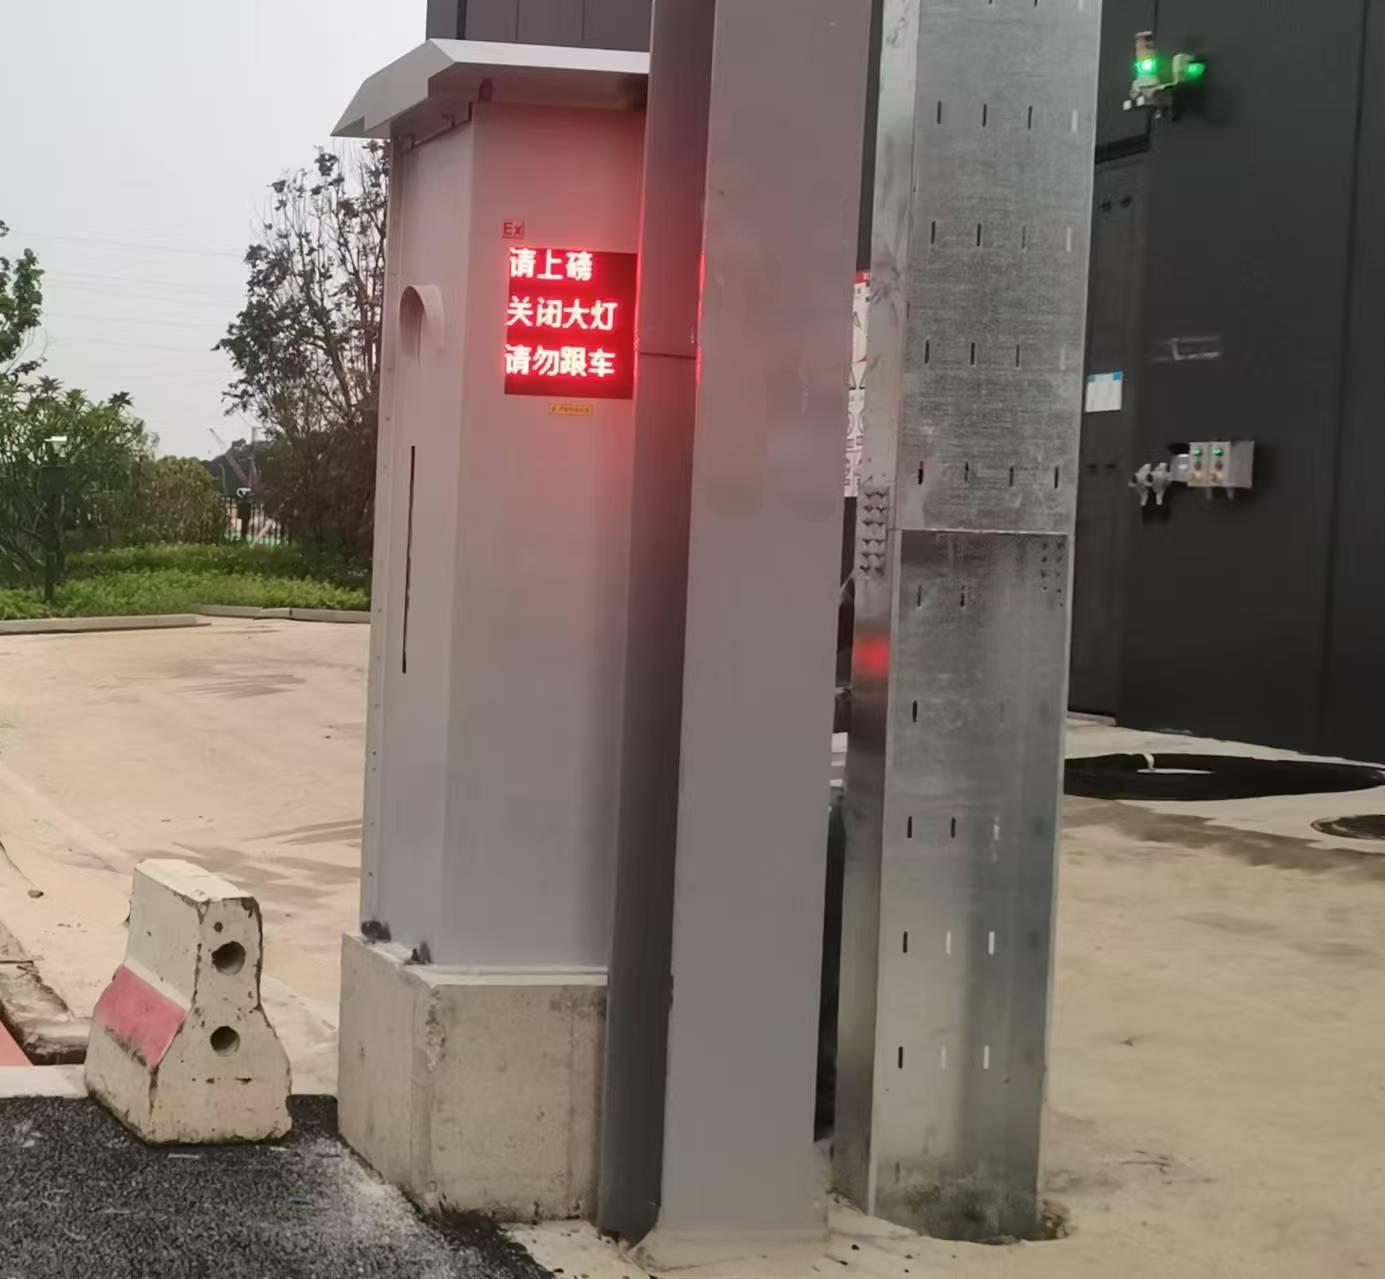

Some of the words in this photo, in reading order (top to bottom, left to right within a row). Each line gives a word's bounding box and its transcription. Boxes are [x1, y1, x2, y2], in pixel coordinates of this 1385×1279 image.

[503, 221, 522, 236] Ex
[509, 247, 593, 281] 请上磅
[506, 296, 618, 331] 关闭大灯
[504, 344, 616, 378] 请勿跟车
